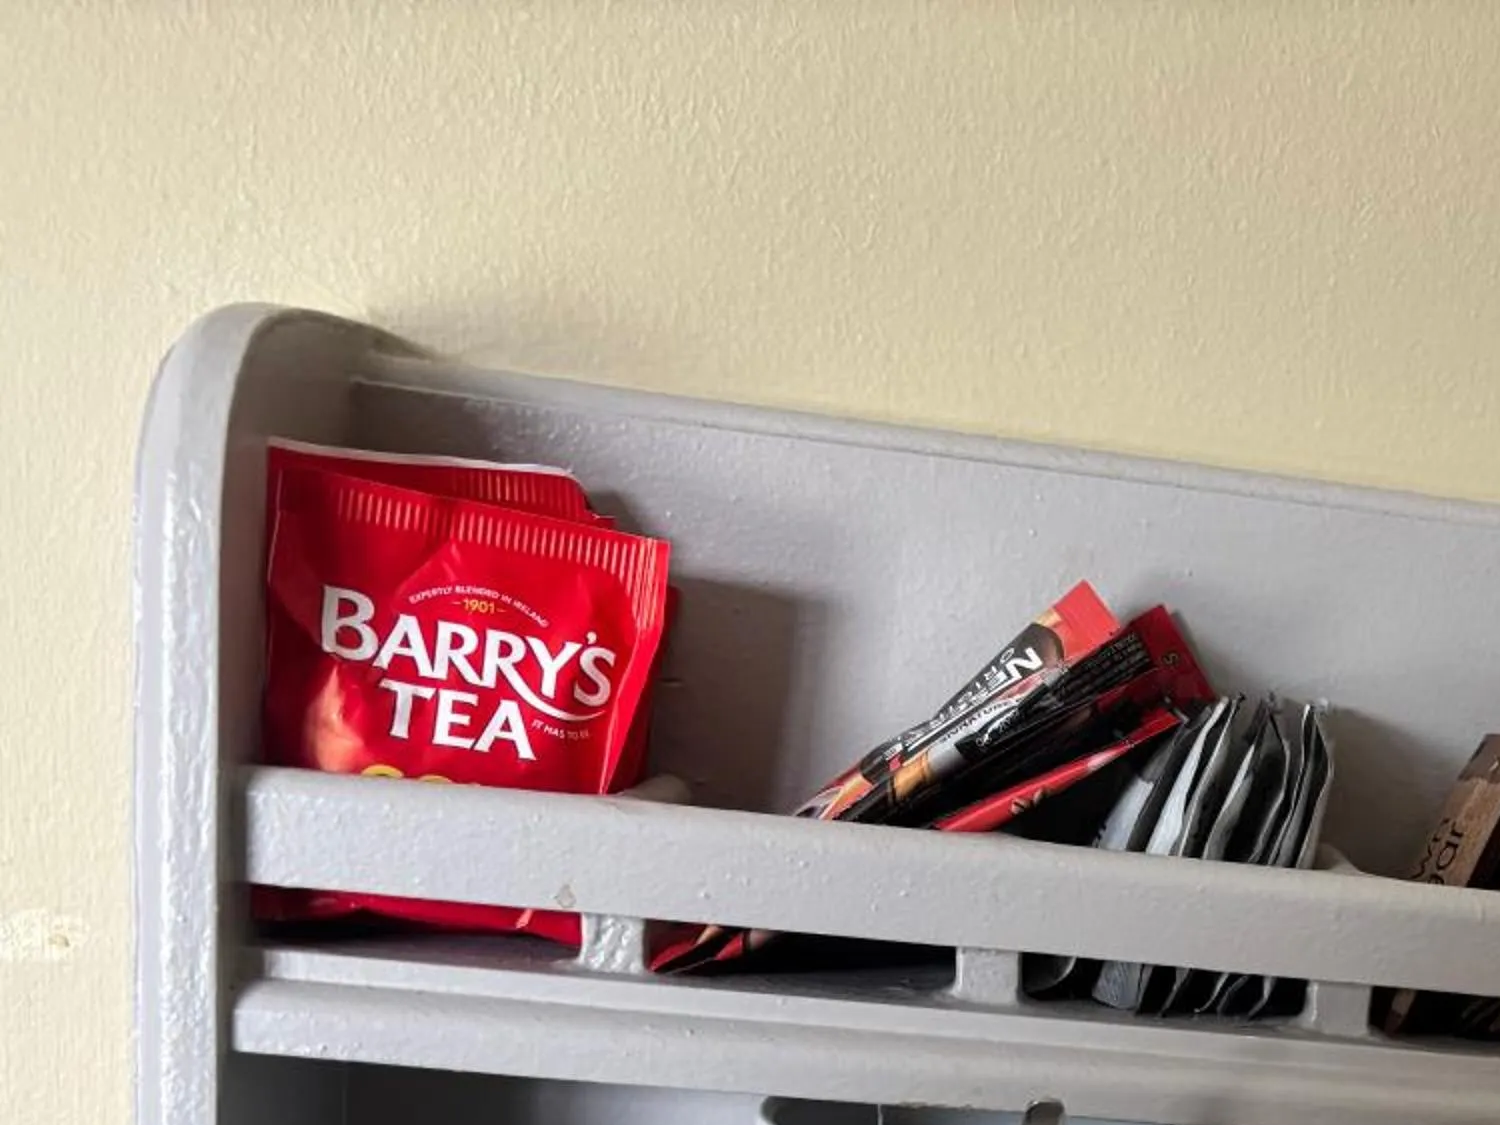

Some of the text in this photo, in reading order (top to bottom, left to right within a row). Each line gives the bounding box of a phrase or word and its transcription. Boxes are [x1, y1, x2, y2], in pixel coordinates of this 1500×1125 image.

[463, 599, 496, 614] 1901
[321, 585, 616, 720] BARRY'S
[380, 679, 536, 760] TEA
